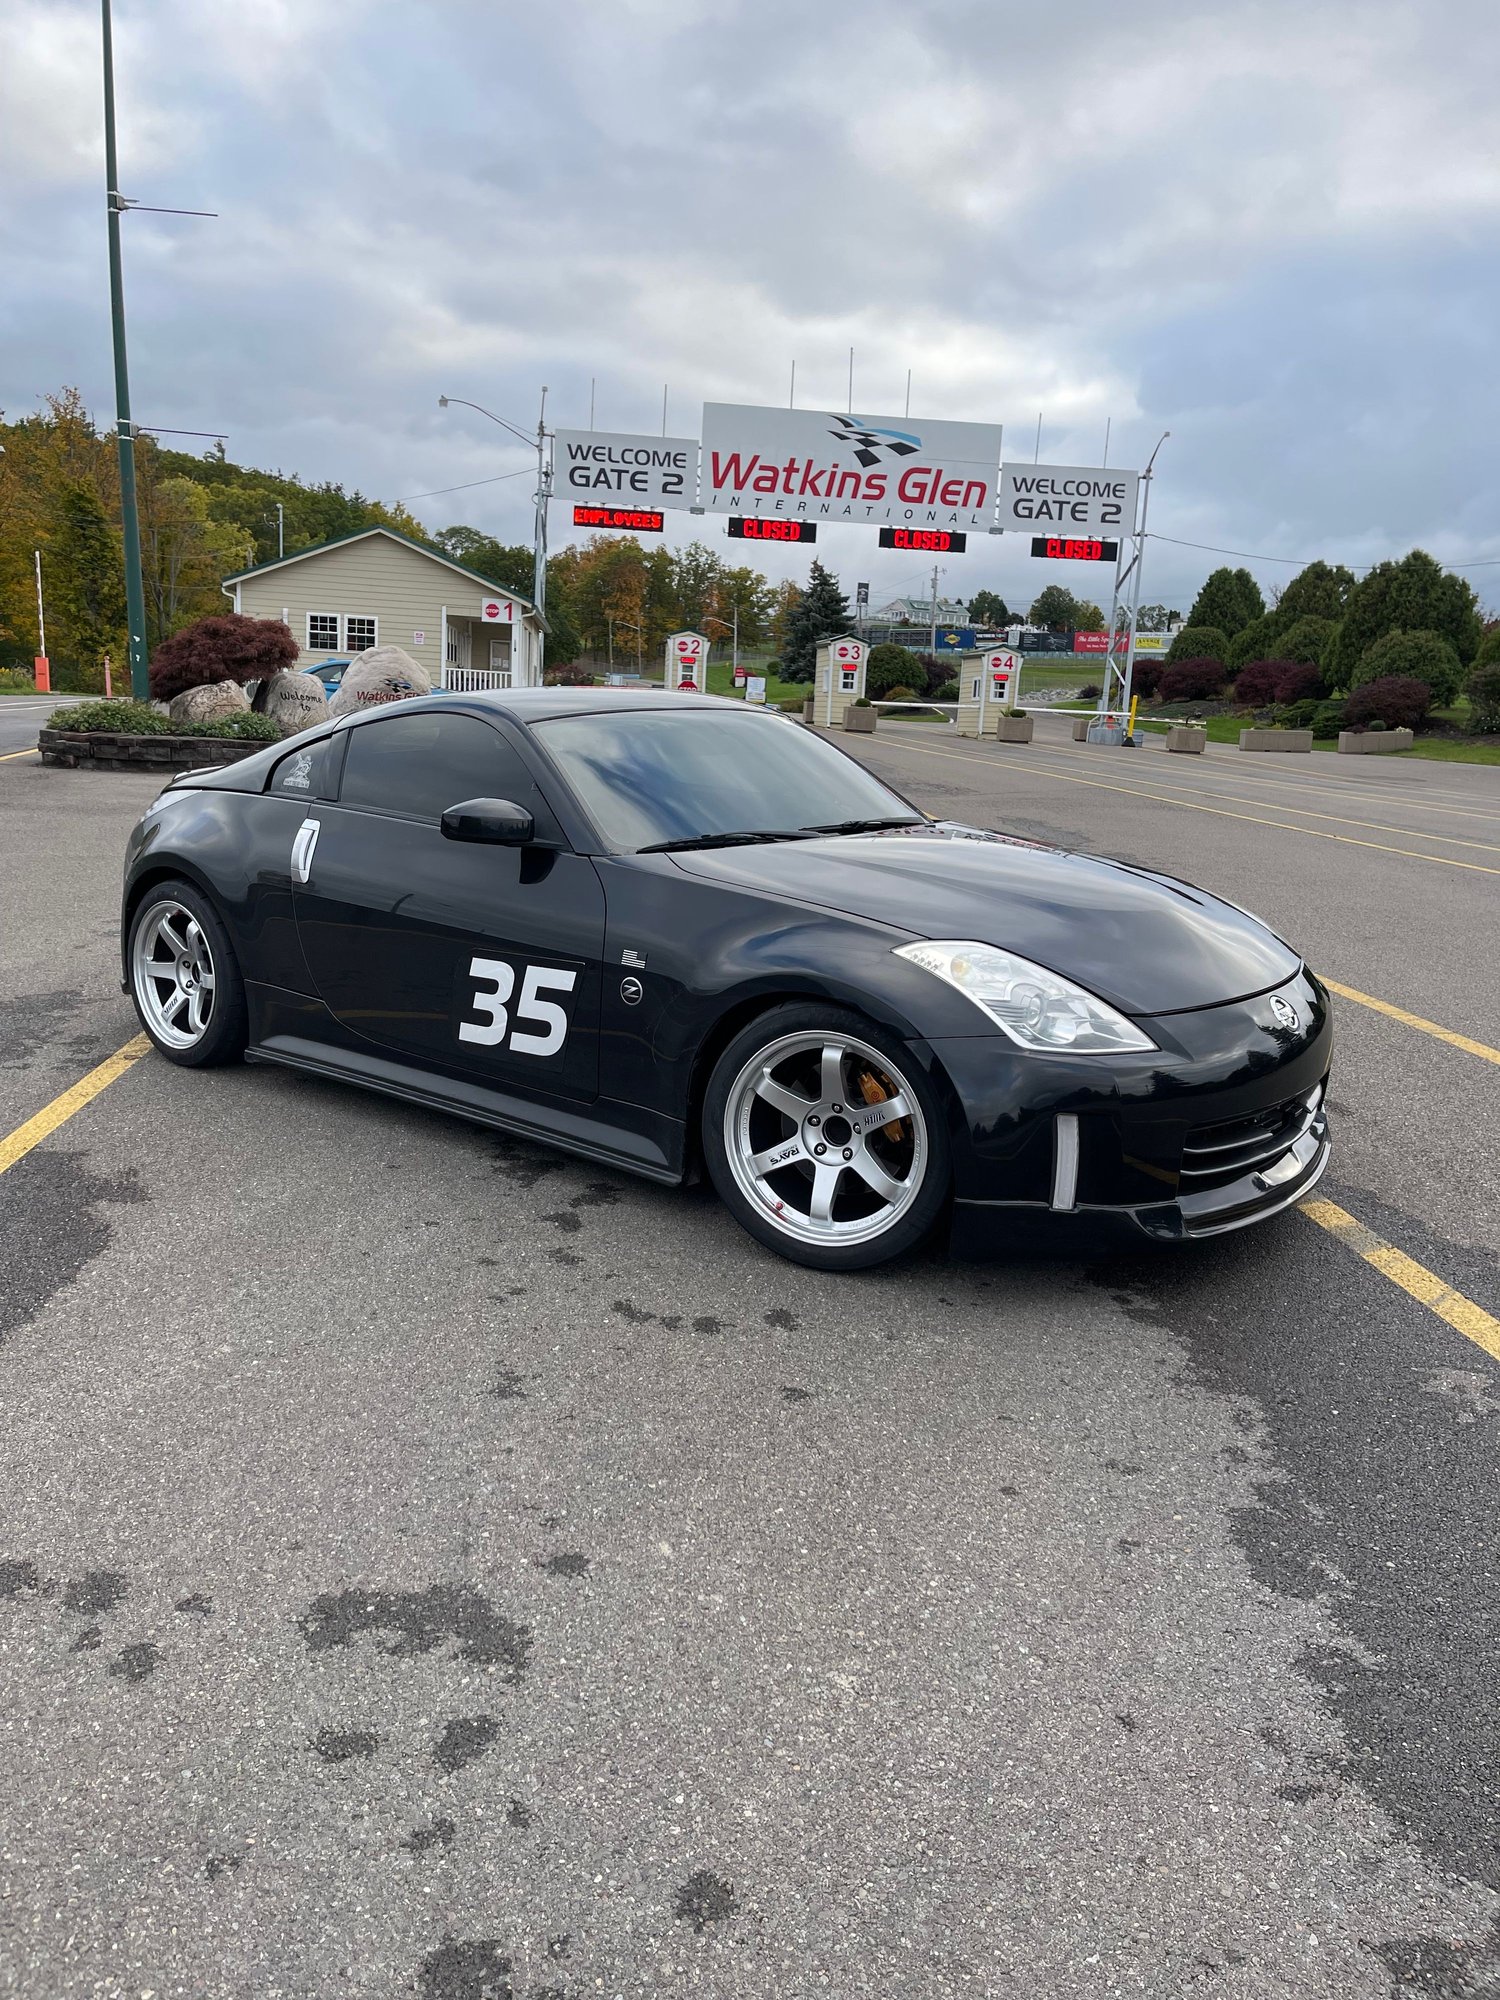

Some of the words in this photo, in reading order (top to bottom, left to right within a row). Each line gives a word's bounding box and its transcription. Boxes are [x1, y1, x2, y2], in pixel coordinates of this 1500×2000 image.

[567, 443, 687, 468] WELCOME
[569, 466, 649, 492] GATE
[662, 472, 684, 494] 2
[711, 452, 888, 500] Watkins
[897, 467, 987, 508] Glen
[1012, 477, 1126, 499] WELCOME
[574, 508, 661, 529] EMPLOYEES
[712, 495, 978, 524] INTERNATIONAL
[1013, 498, 1088, 522] GATE
[1100, 503, 1122, 524] 2
[743, 521, 800, 541] CLOSED
[894, 529, 950, 551] CLOSED
[1046, 539, 1102, 560] CLOSED
[504, 602, 513, 621] 1
[690, 640, 700, 654] 2
[851, 645, 860, 660] 3
[1004, 655, 1013, 670] 4
[280, 691, 322, 703] Welcome
[357, 691, 401, 701] Watkins
[300, 703, 311, 711] to
[458, 957, 577, 1057] 35
[770, 1147, 800, 1165] RAYS
